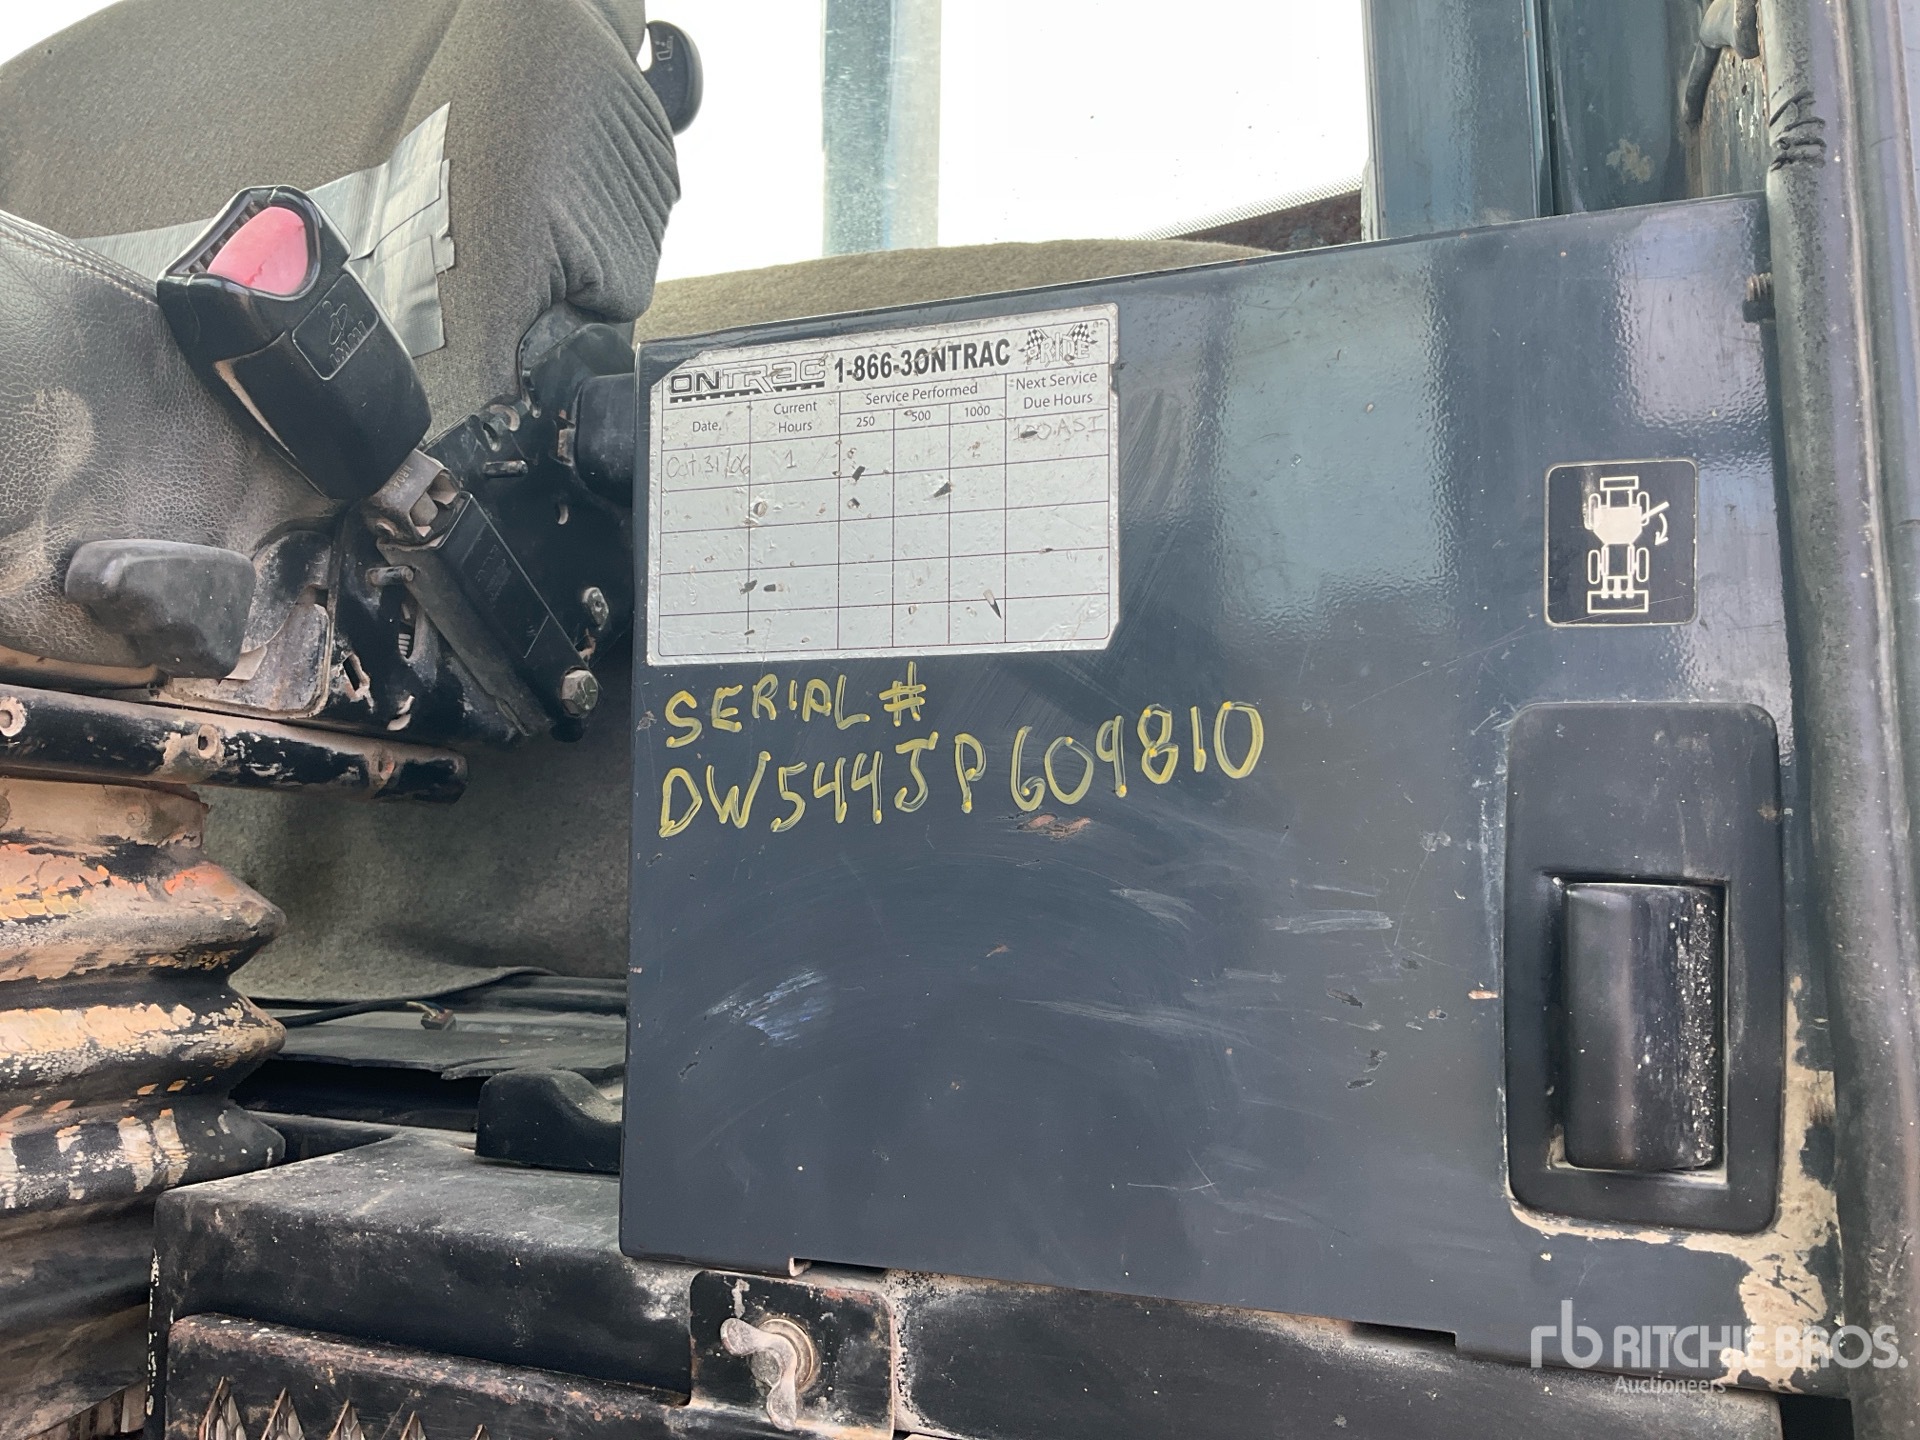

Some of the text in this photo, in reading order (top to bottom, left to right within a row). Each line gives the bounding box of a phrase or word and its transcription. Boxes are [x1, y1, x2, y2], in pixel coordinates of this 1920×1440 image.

[1016, 371, 1098, 390] Next Service
[865, 382, 978, 406] Service Performed
[1023, 393, 1093, 410] Due Hours
[773, 401, 817, 416] Current
[911, 410, 931, 422] 500
[964, 405, 991, 417] 1000
[778, 422, 813, 433] Hours
[856, 416, 875, 428] 250
[665, 661, 927, 748] SERIAL #
